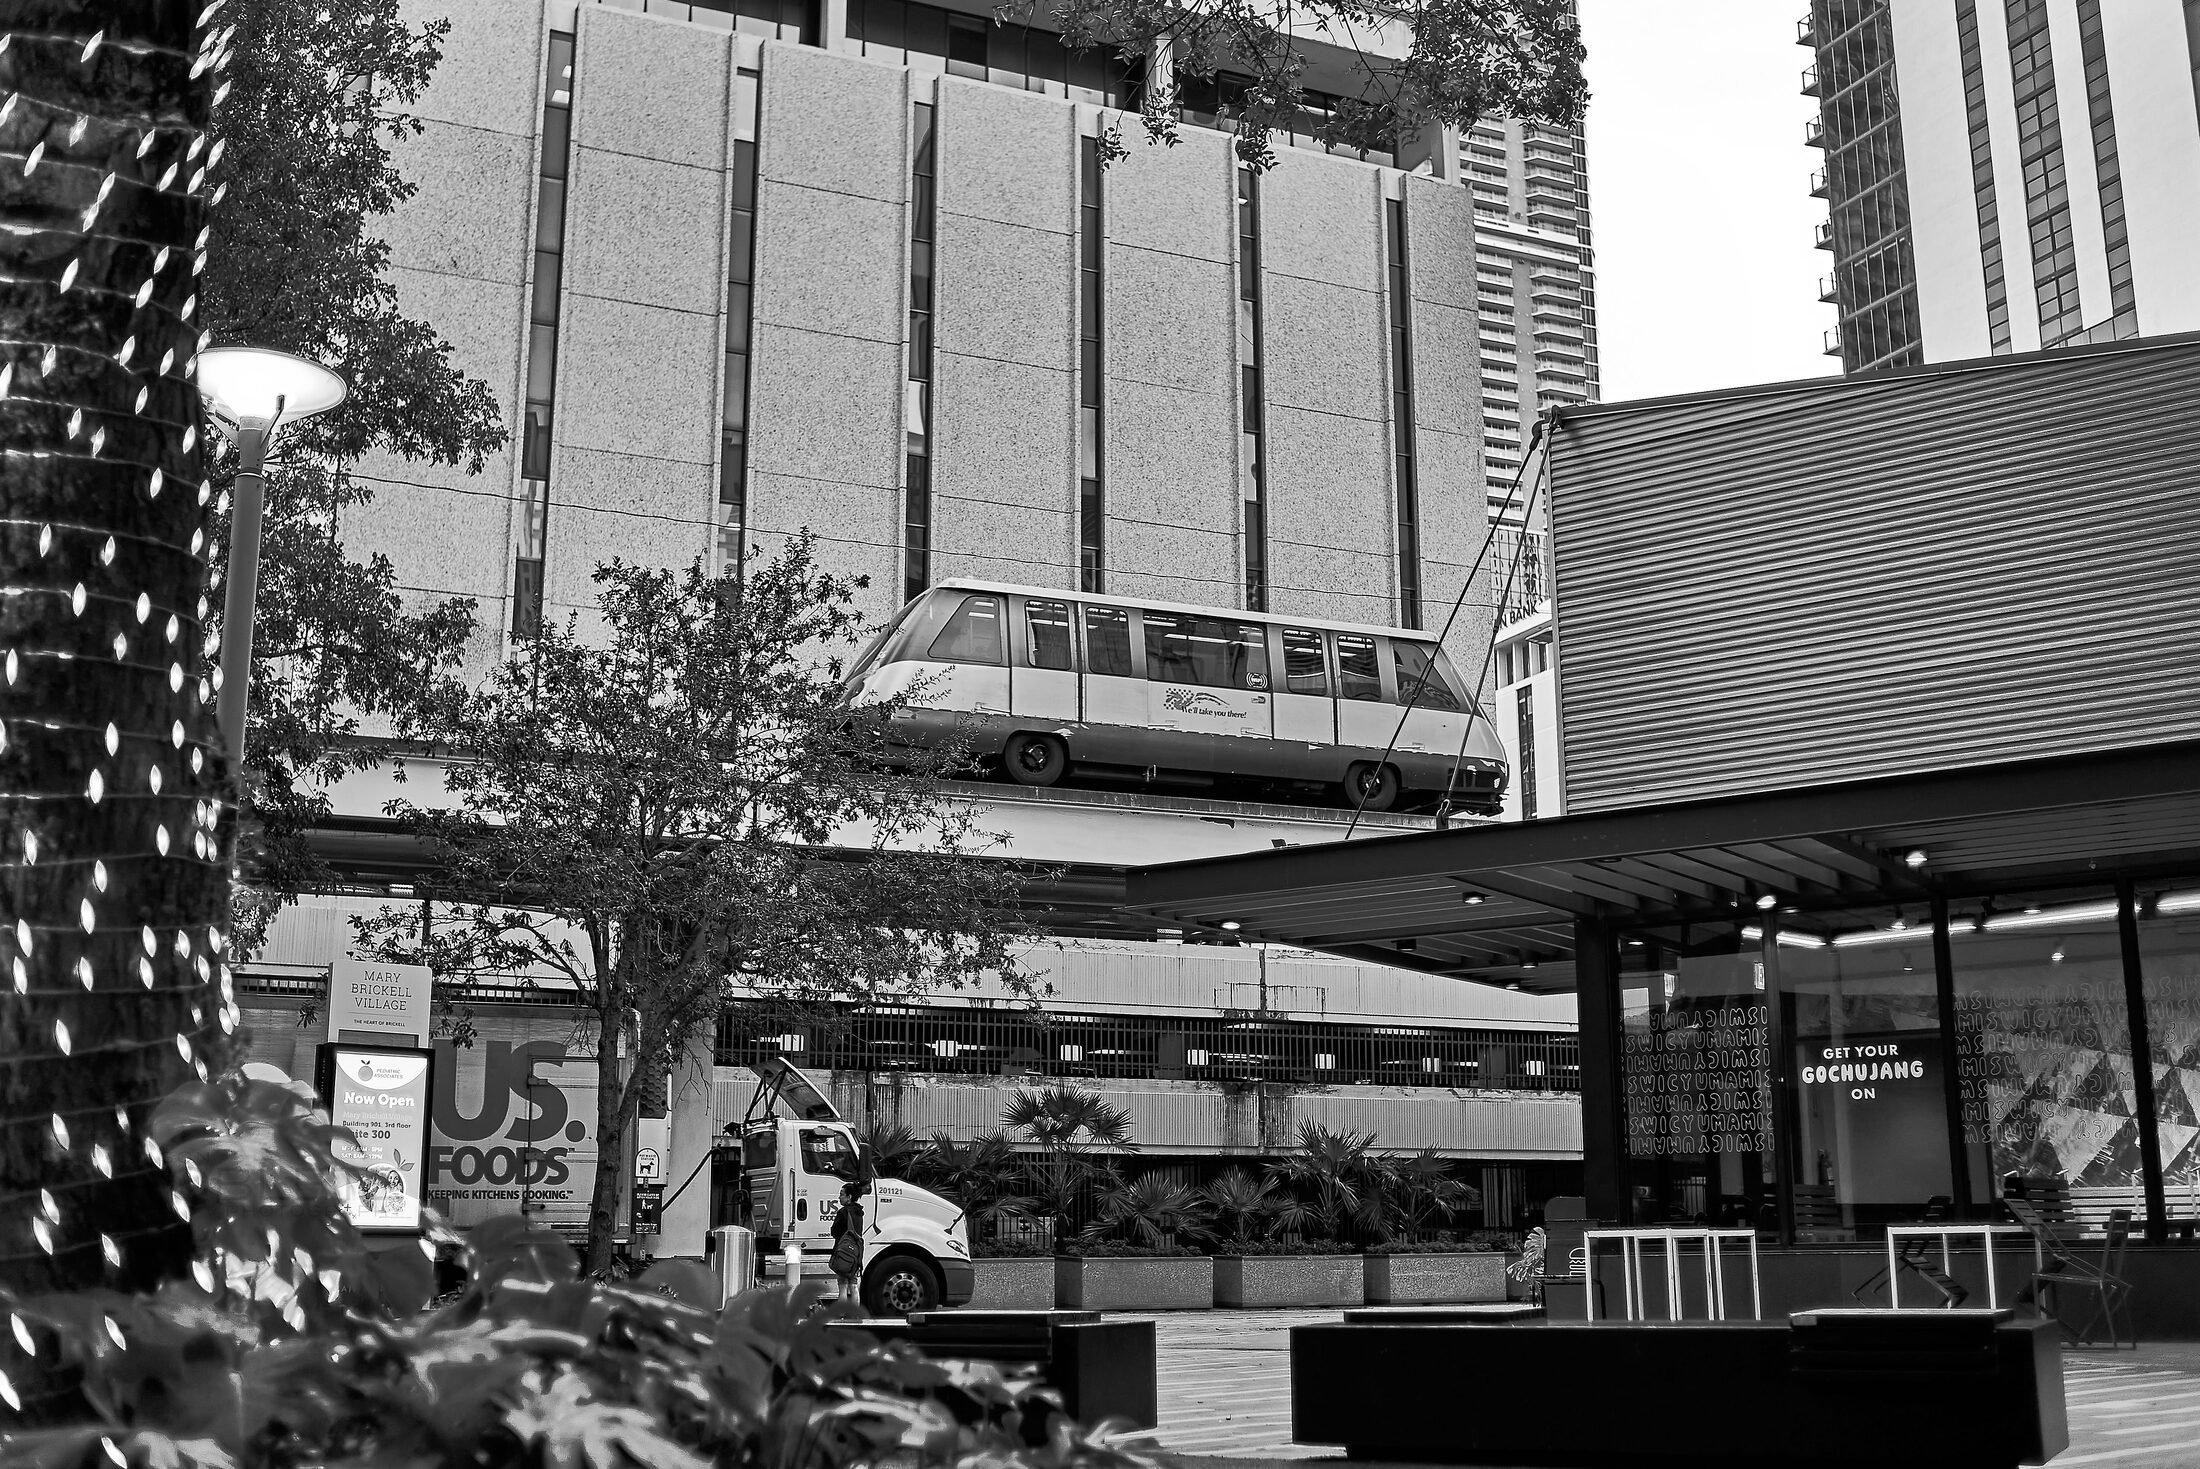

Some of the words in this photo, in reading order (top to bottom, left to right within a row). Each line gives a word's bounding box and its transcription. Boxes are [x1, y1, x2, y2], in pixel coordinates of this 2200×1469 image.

[1199, 708, 1213, 716] take
[1214, 710, 1226, 718] you
[1227, 710, 1247, 719] there!
[364, 970, 401, 983] MARY
[351, 983, 412, 998] BRICKELL
[355, 997, 407, 1011] VILLAGE
[1823, 1047, 1850, 1059] GET
[1855, 1044, 1898, 1058] YOUR
[1802, 1060, 1924, 1084] GOCHUJANG
[343, 1091, 376, 1105] Now
[377, 1093, 415, 1109] Open
[1851, 1088, 1876, 1100] ON
[342, 1120, 369, 1128] Building
[371, 1130, 391, 1139] 300
[429, 1146, 569, 1185] FOODS
[428, 1189, 470, 1200] KEEPING
[471, 1189, 519, 1200] KITCHENS
[878, 1187, 903, 1195] 201121
